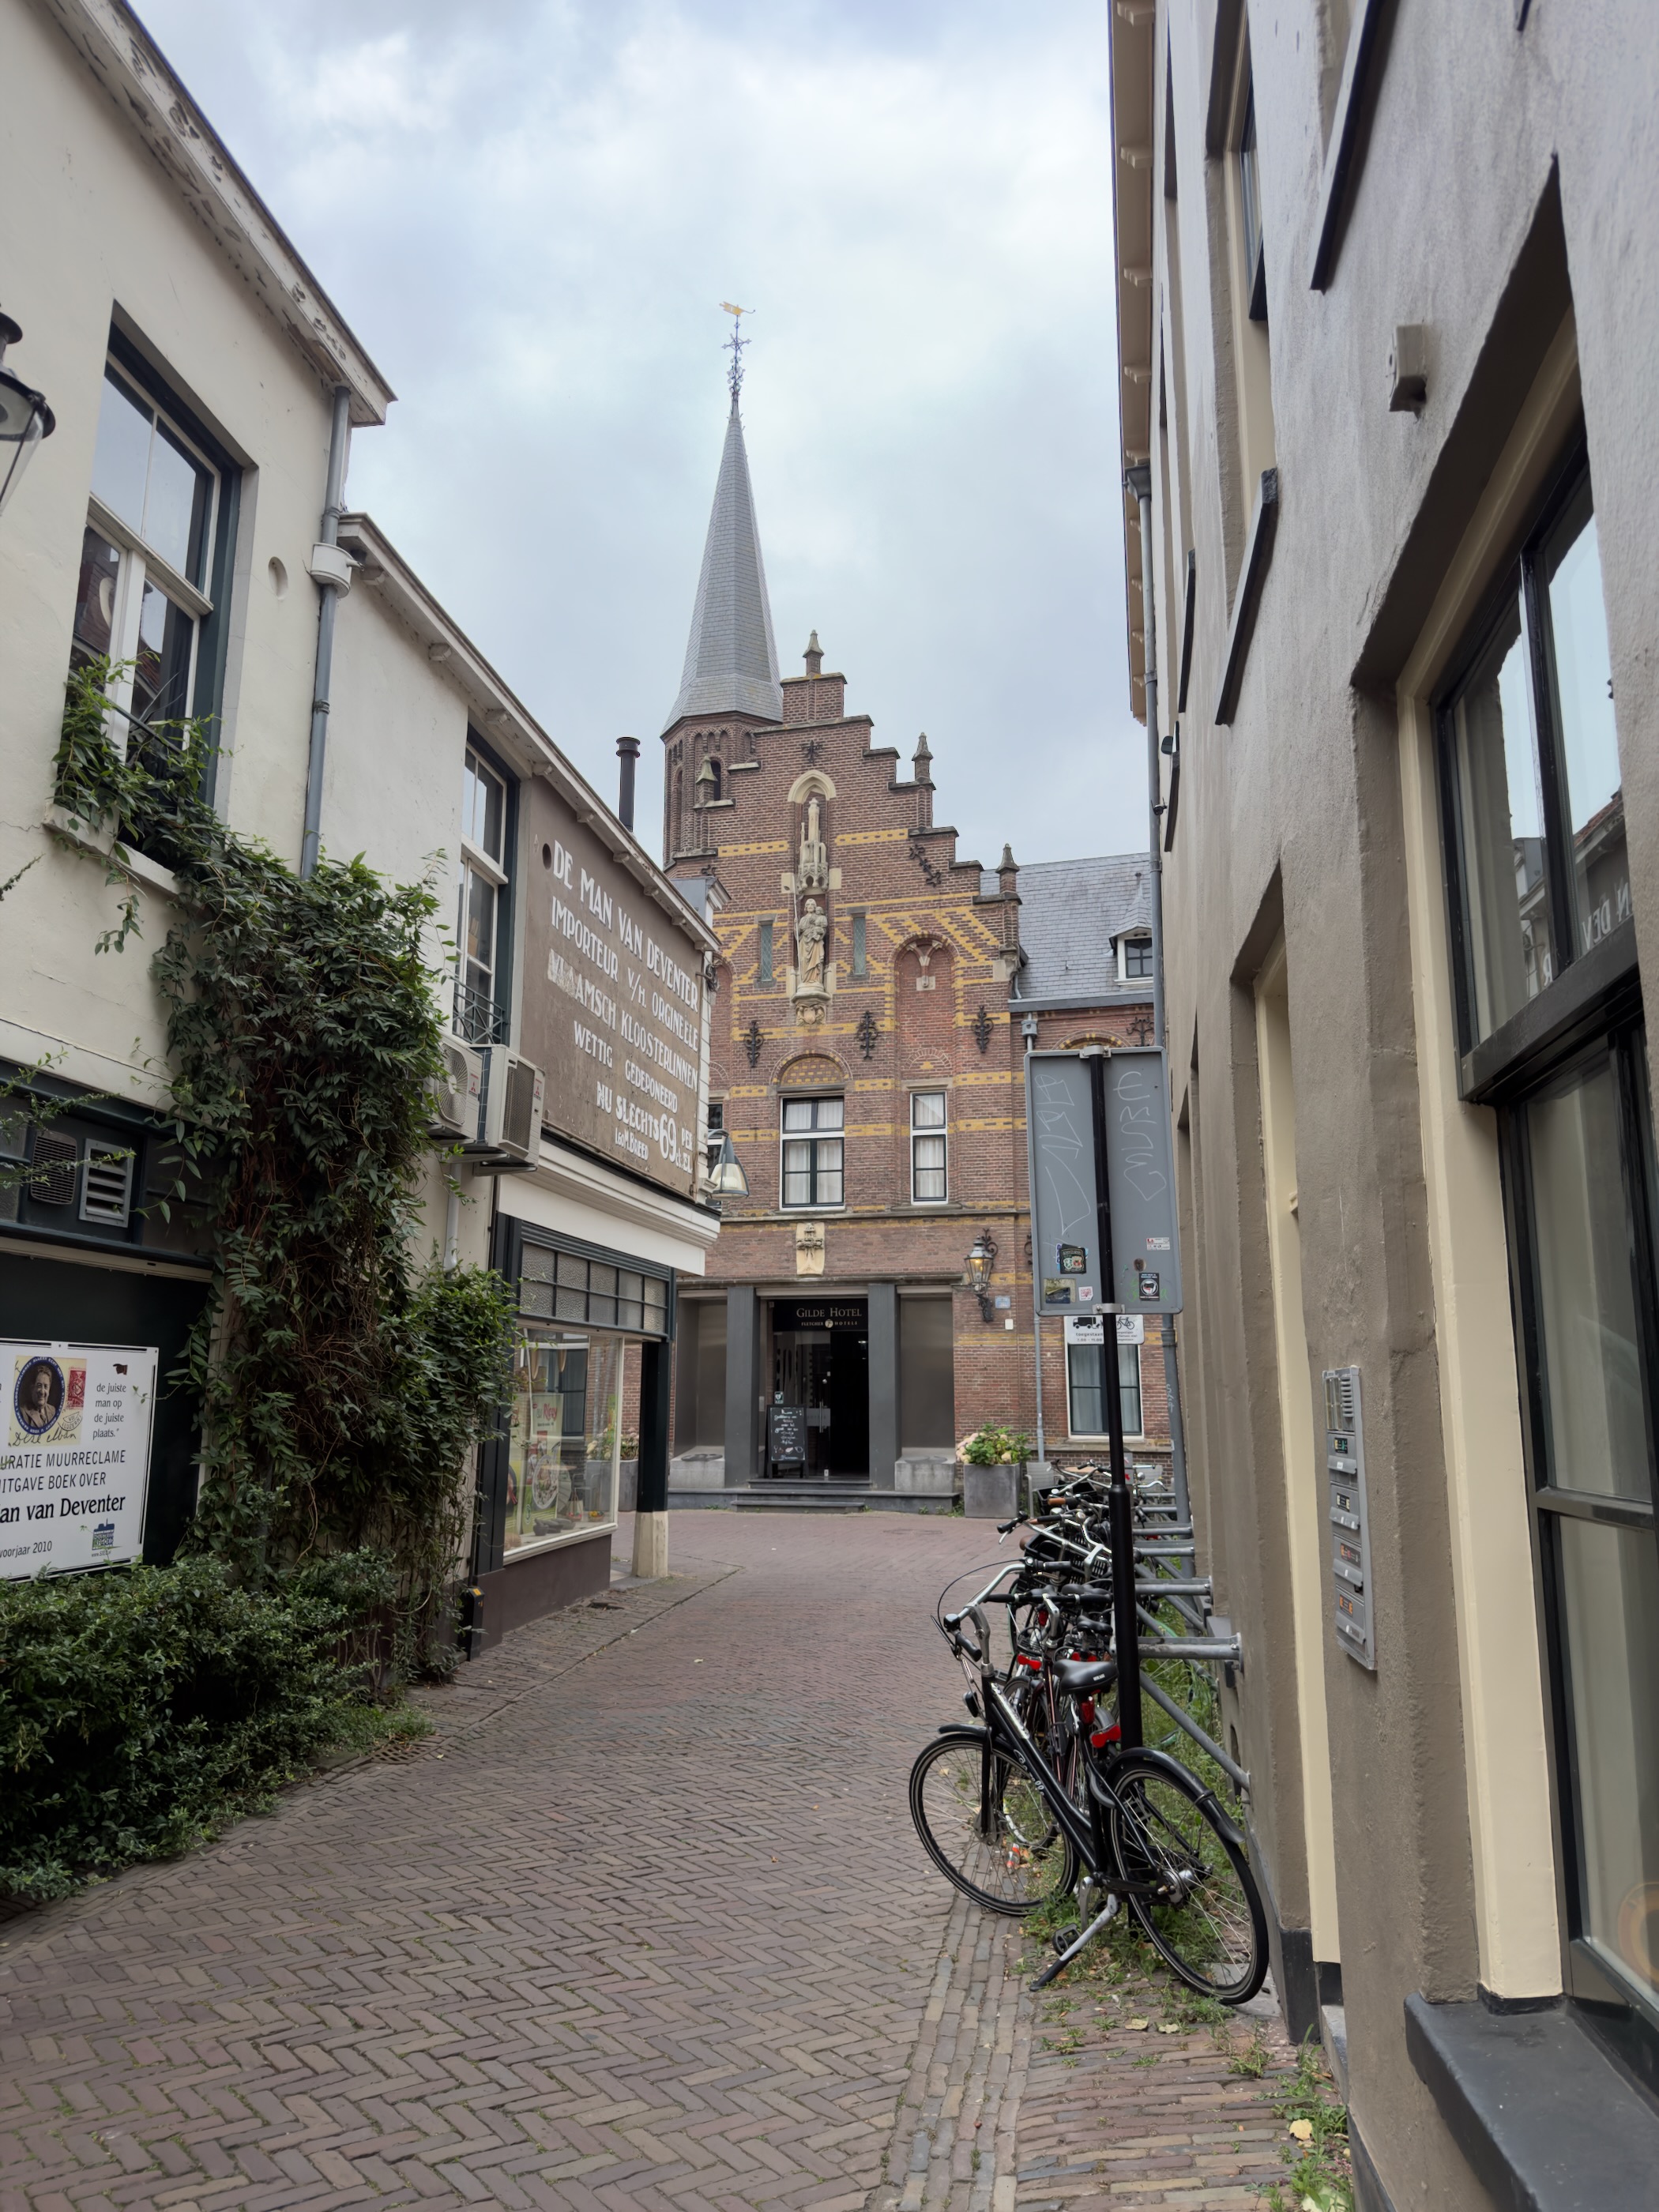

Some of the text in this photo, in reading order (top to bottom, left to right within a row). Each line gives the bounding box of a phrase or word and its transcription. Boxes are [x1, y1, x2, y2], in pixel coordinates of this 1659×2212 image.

[553, 840, 698, 1012] DE MAN VAN DEVENTER
[551, 896, 619, 982] IMPORTEUR
[620, 1010, 698, 1093] KLOOSTERLINNEN
[574, 1020, 678, 1113] WETTIG GEDEPONEERD
[596, 1081, 612, 1114] NU
[616, 1095, 659, 1142] SLECHTS
[659, 1113, 677, 1163] 69
[96, 1382, 126, 1395] de juiste
[112, 1400, 122, 1410] op
[93, 1413, 124, 1425] de juiste
[46, 1450, 126, 1468] MUURRECLAME
[0, 1472, 107, 1494] ITGAVE BOEK OVER
[26, 1502, 55, 1521] van
[59, 1493, 126, 1518] Deventer
[32, 1540, 53, 1554] 2010
